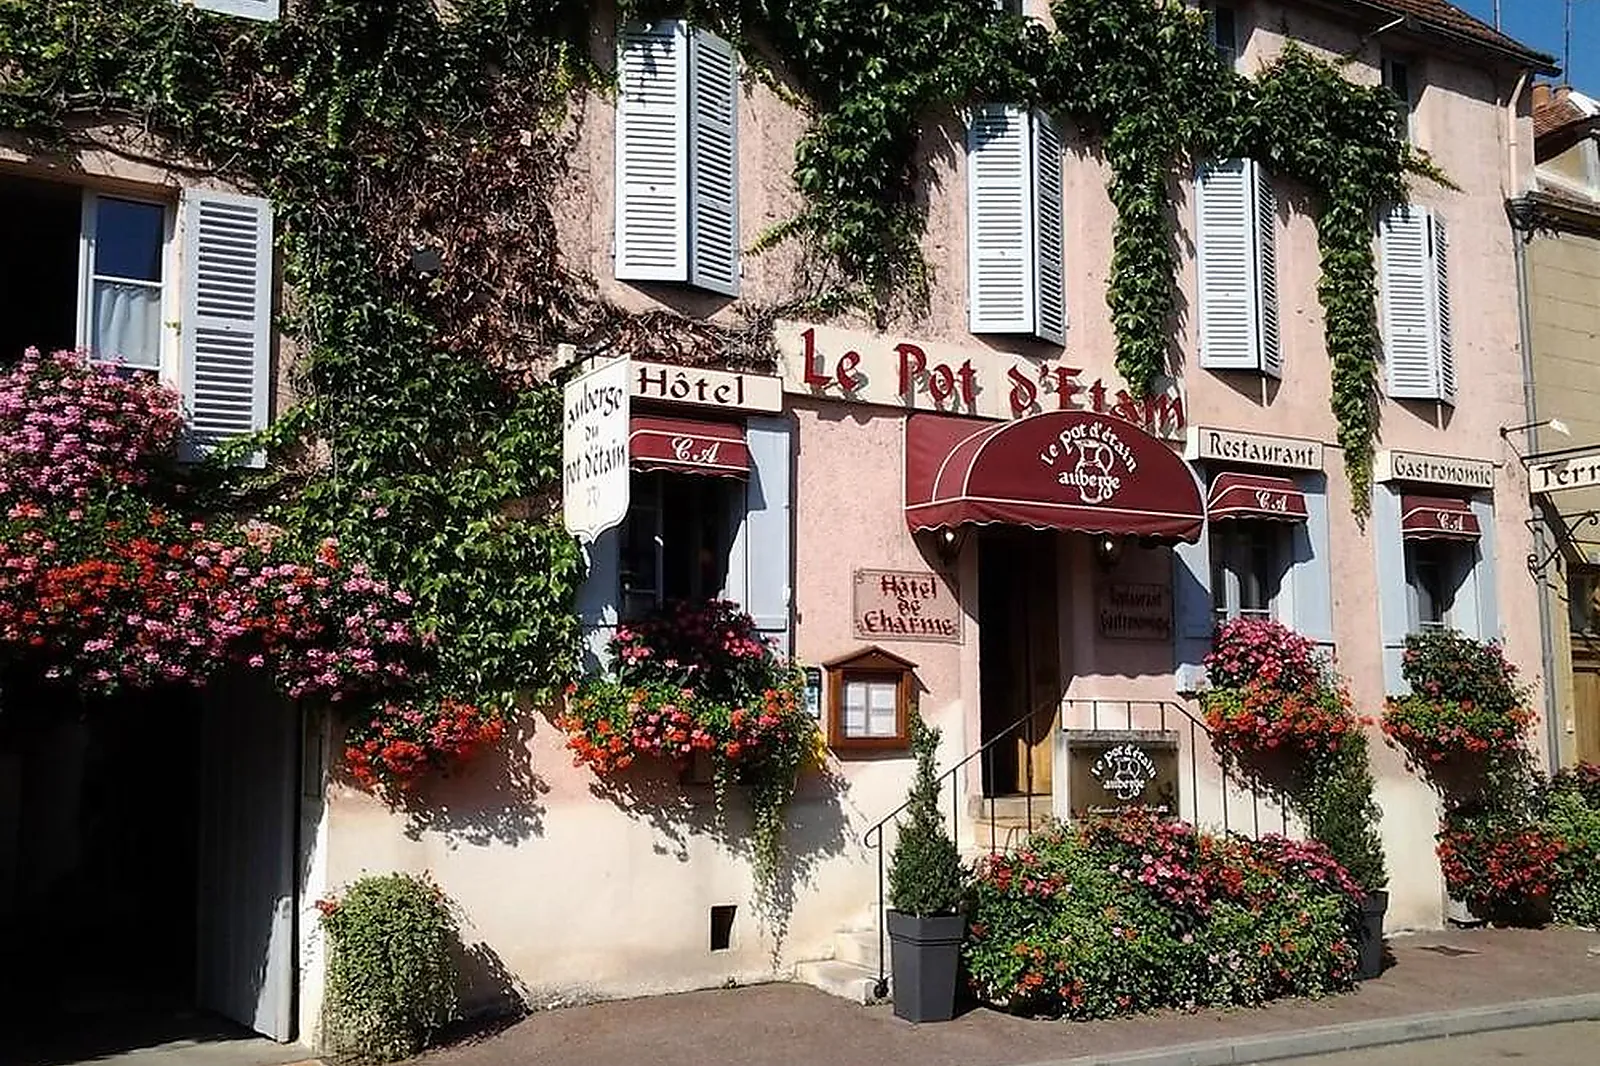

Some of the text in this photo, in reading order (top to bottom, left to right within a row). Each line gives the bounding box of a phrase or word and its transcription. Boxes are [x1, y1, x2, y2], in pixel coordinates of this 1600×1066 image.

[801, 328, 860, 390] Le
[894, 343, 978, 405] Pot
[638, 367, 744, 405] Hôtel
[567, 381, 623, 430] auberge
[585, 425, 599, 441] du
[1060, 424, 1087, 455] pot
[1089, 421, 1137, 473] d'étain
[1209, 432, 1315, 466] Restaurant
[565, 453, 581, 496] pot
[1058, 470, 1121, 499] auberge
[1394, 455, 1491, 485] Gastronomie
[881, 574, 937, 599] Hôtel
[897, 596, 921, 616] de
[864, 609, 953, 636] Charme
